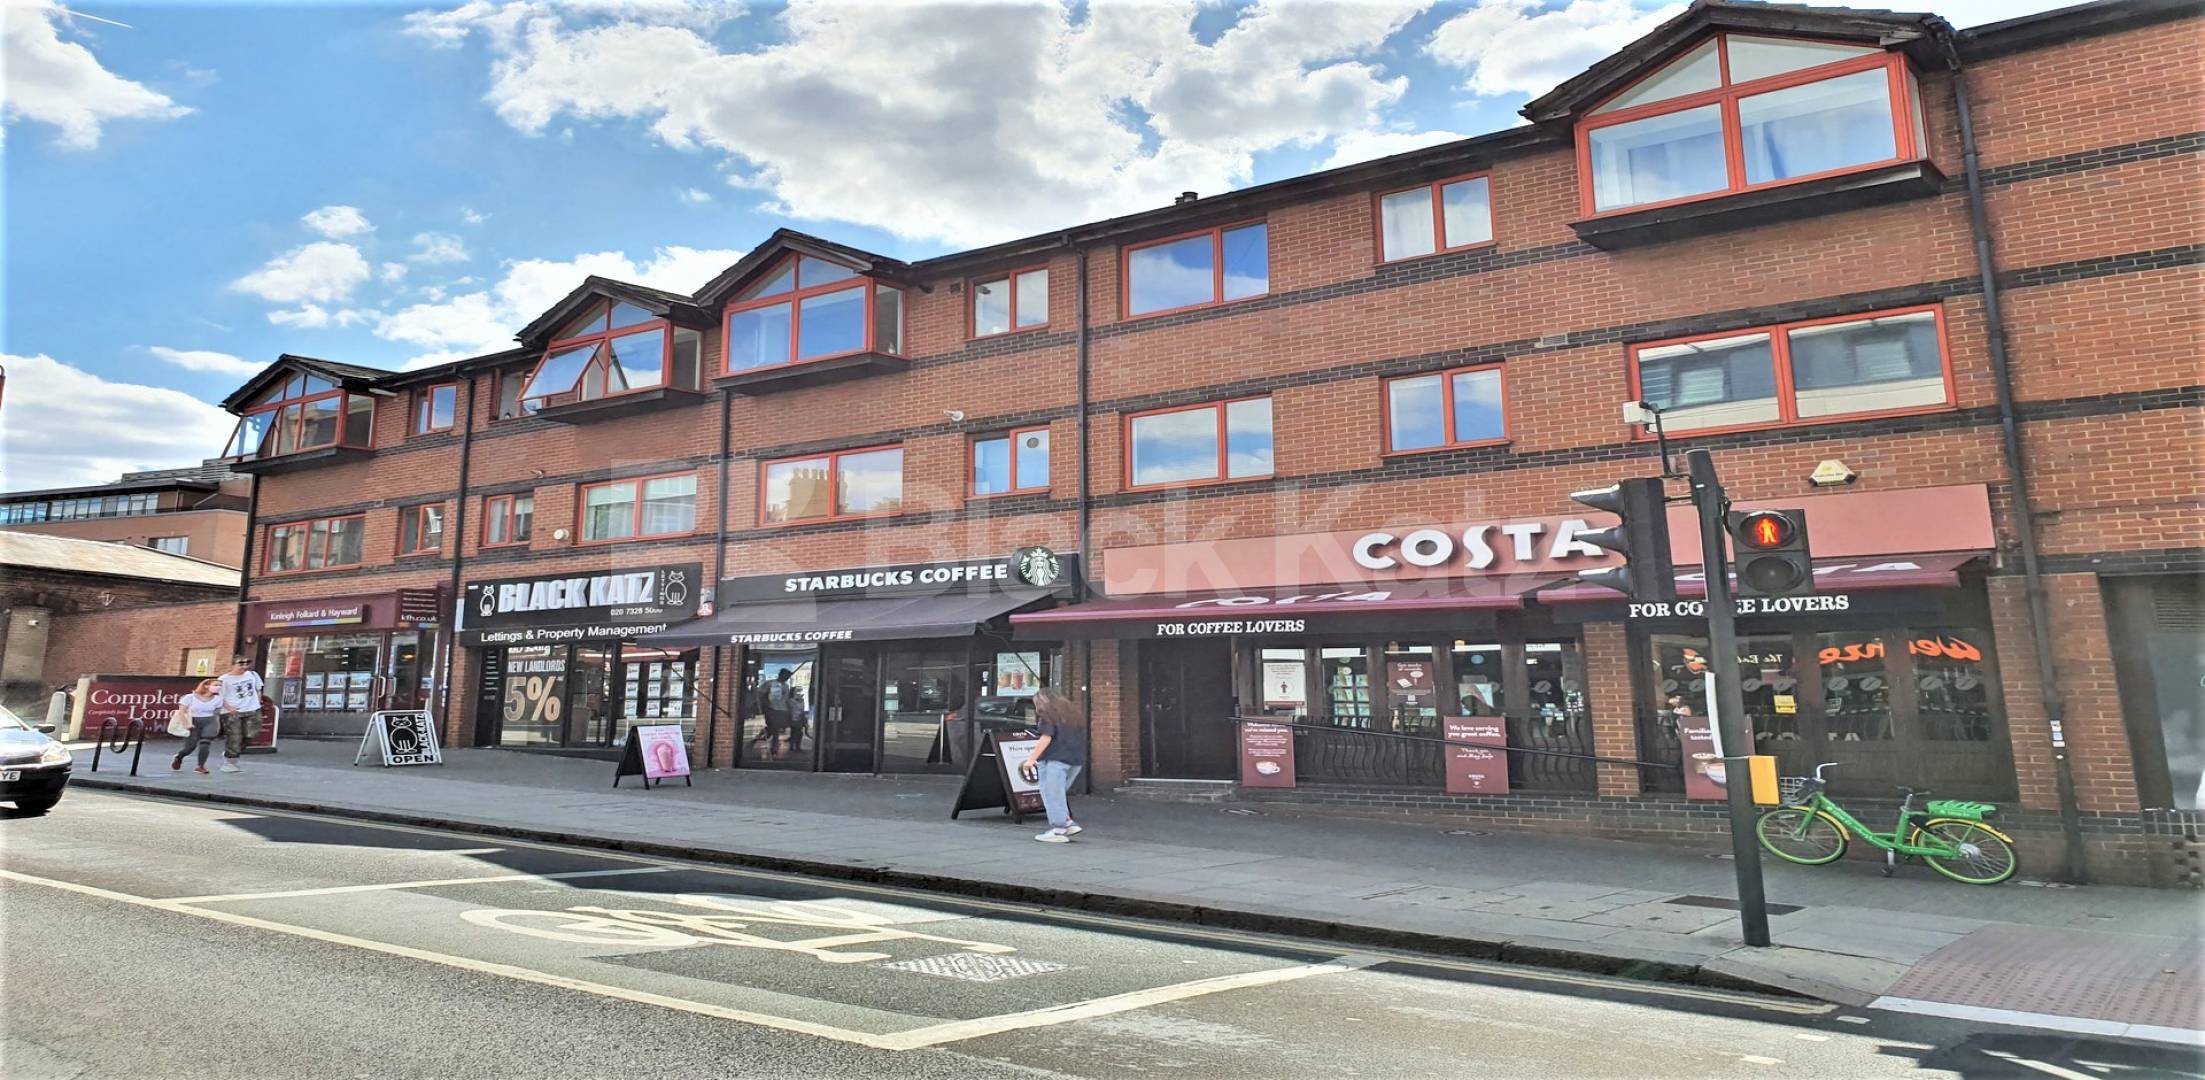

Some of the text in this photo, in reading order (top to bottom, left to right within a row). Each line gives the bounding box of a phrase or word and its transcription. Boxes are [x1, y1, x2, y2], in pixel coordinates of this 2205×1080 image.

[1353, 518, 1608, 570] COSTA
[785, 563, 1008, 593] STARBUCKS COFFEE
[498, 571, 656, 613] BLACK KATZ
[320, 609, 327, 617] &
[328, 607, 358, 618] Hayward
[610, 608, 624, 616] 020
[1629, 602, 1671, 618] FOR
[1761, 594, 1850, 614] LOVERS
[481, 623, 667, 643] Lettings & Property Management
[1157, 619, 1305, 635] FOR COFFEE LOVERS
[730, 630, 853, 644] STARBUCKS COFFEE
[508, 659, 566, 673] NEW LANDLORDS
[91, 689, 182, 709] Complet
[503, 675, 561, 721] 5%
[392, 754, 434, 764] OPEN
[1, 772, 18, 780] YE
